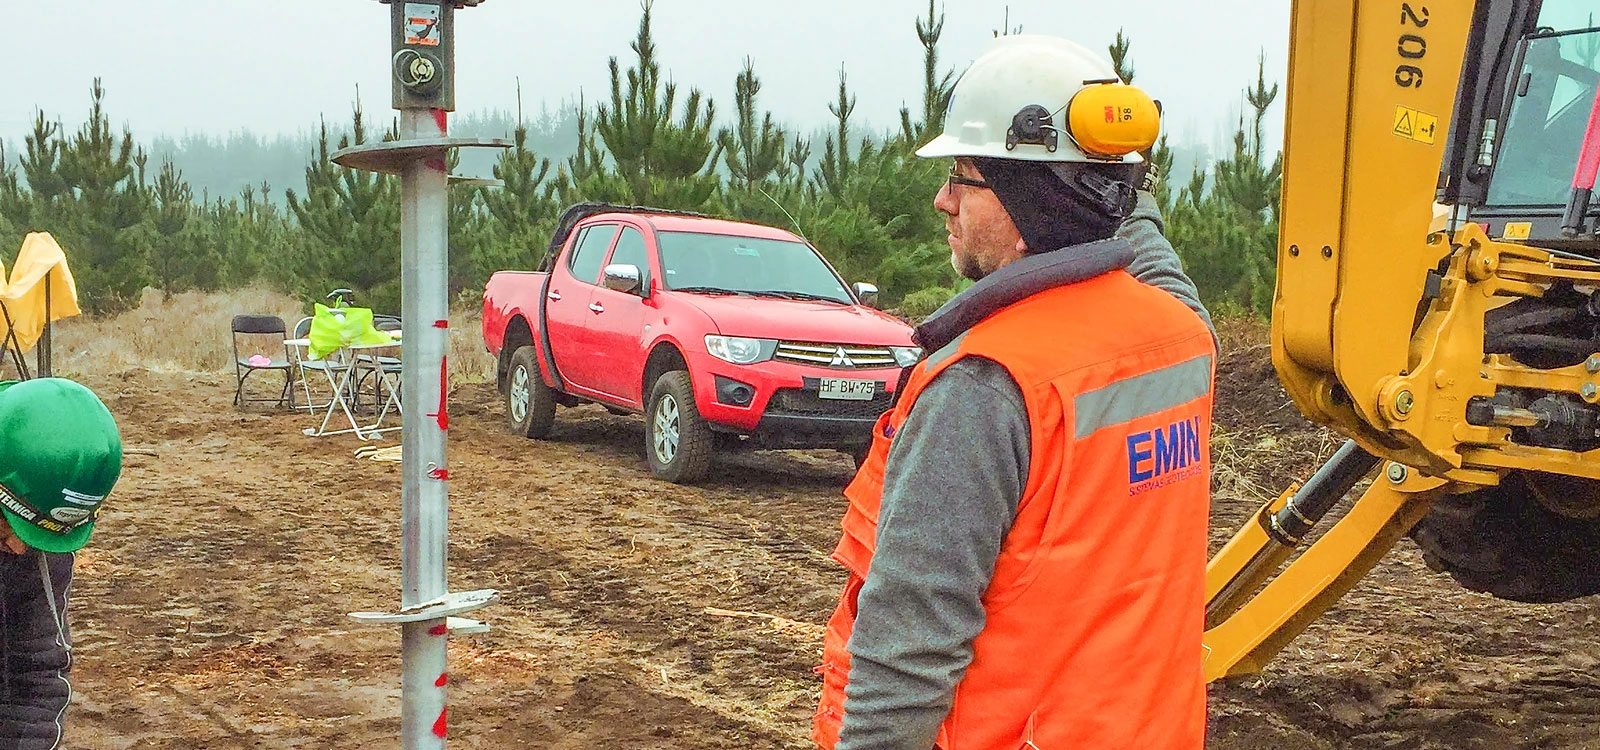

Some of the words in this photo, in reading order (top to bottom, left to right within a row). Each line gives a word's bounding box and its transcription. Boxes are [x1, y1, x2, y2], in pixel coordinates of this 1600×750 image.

[1395, 2, 1429, 88] 206
[1104, 105, 1114, 123] 3M
[822, 380, 837, 392] HF
[1127, 415, 1200, 484] EMIN
[0, 488, 37, 521] TEKNICA
